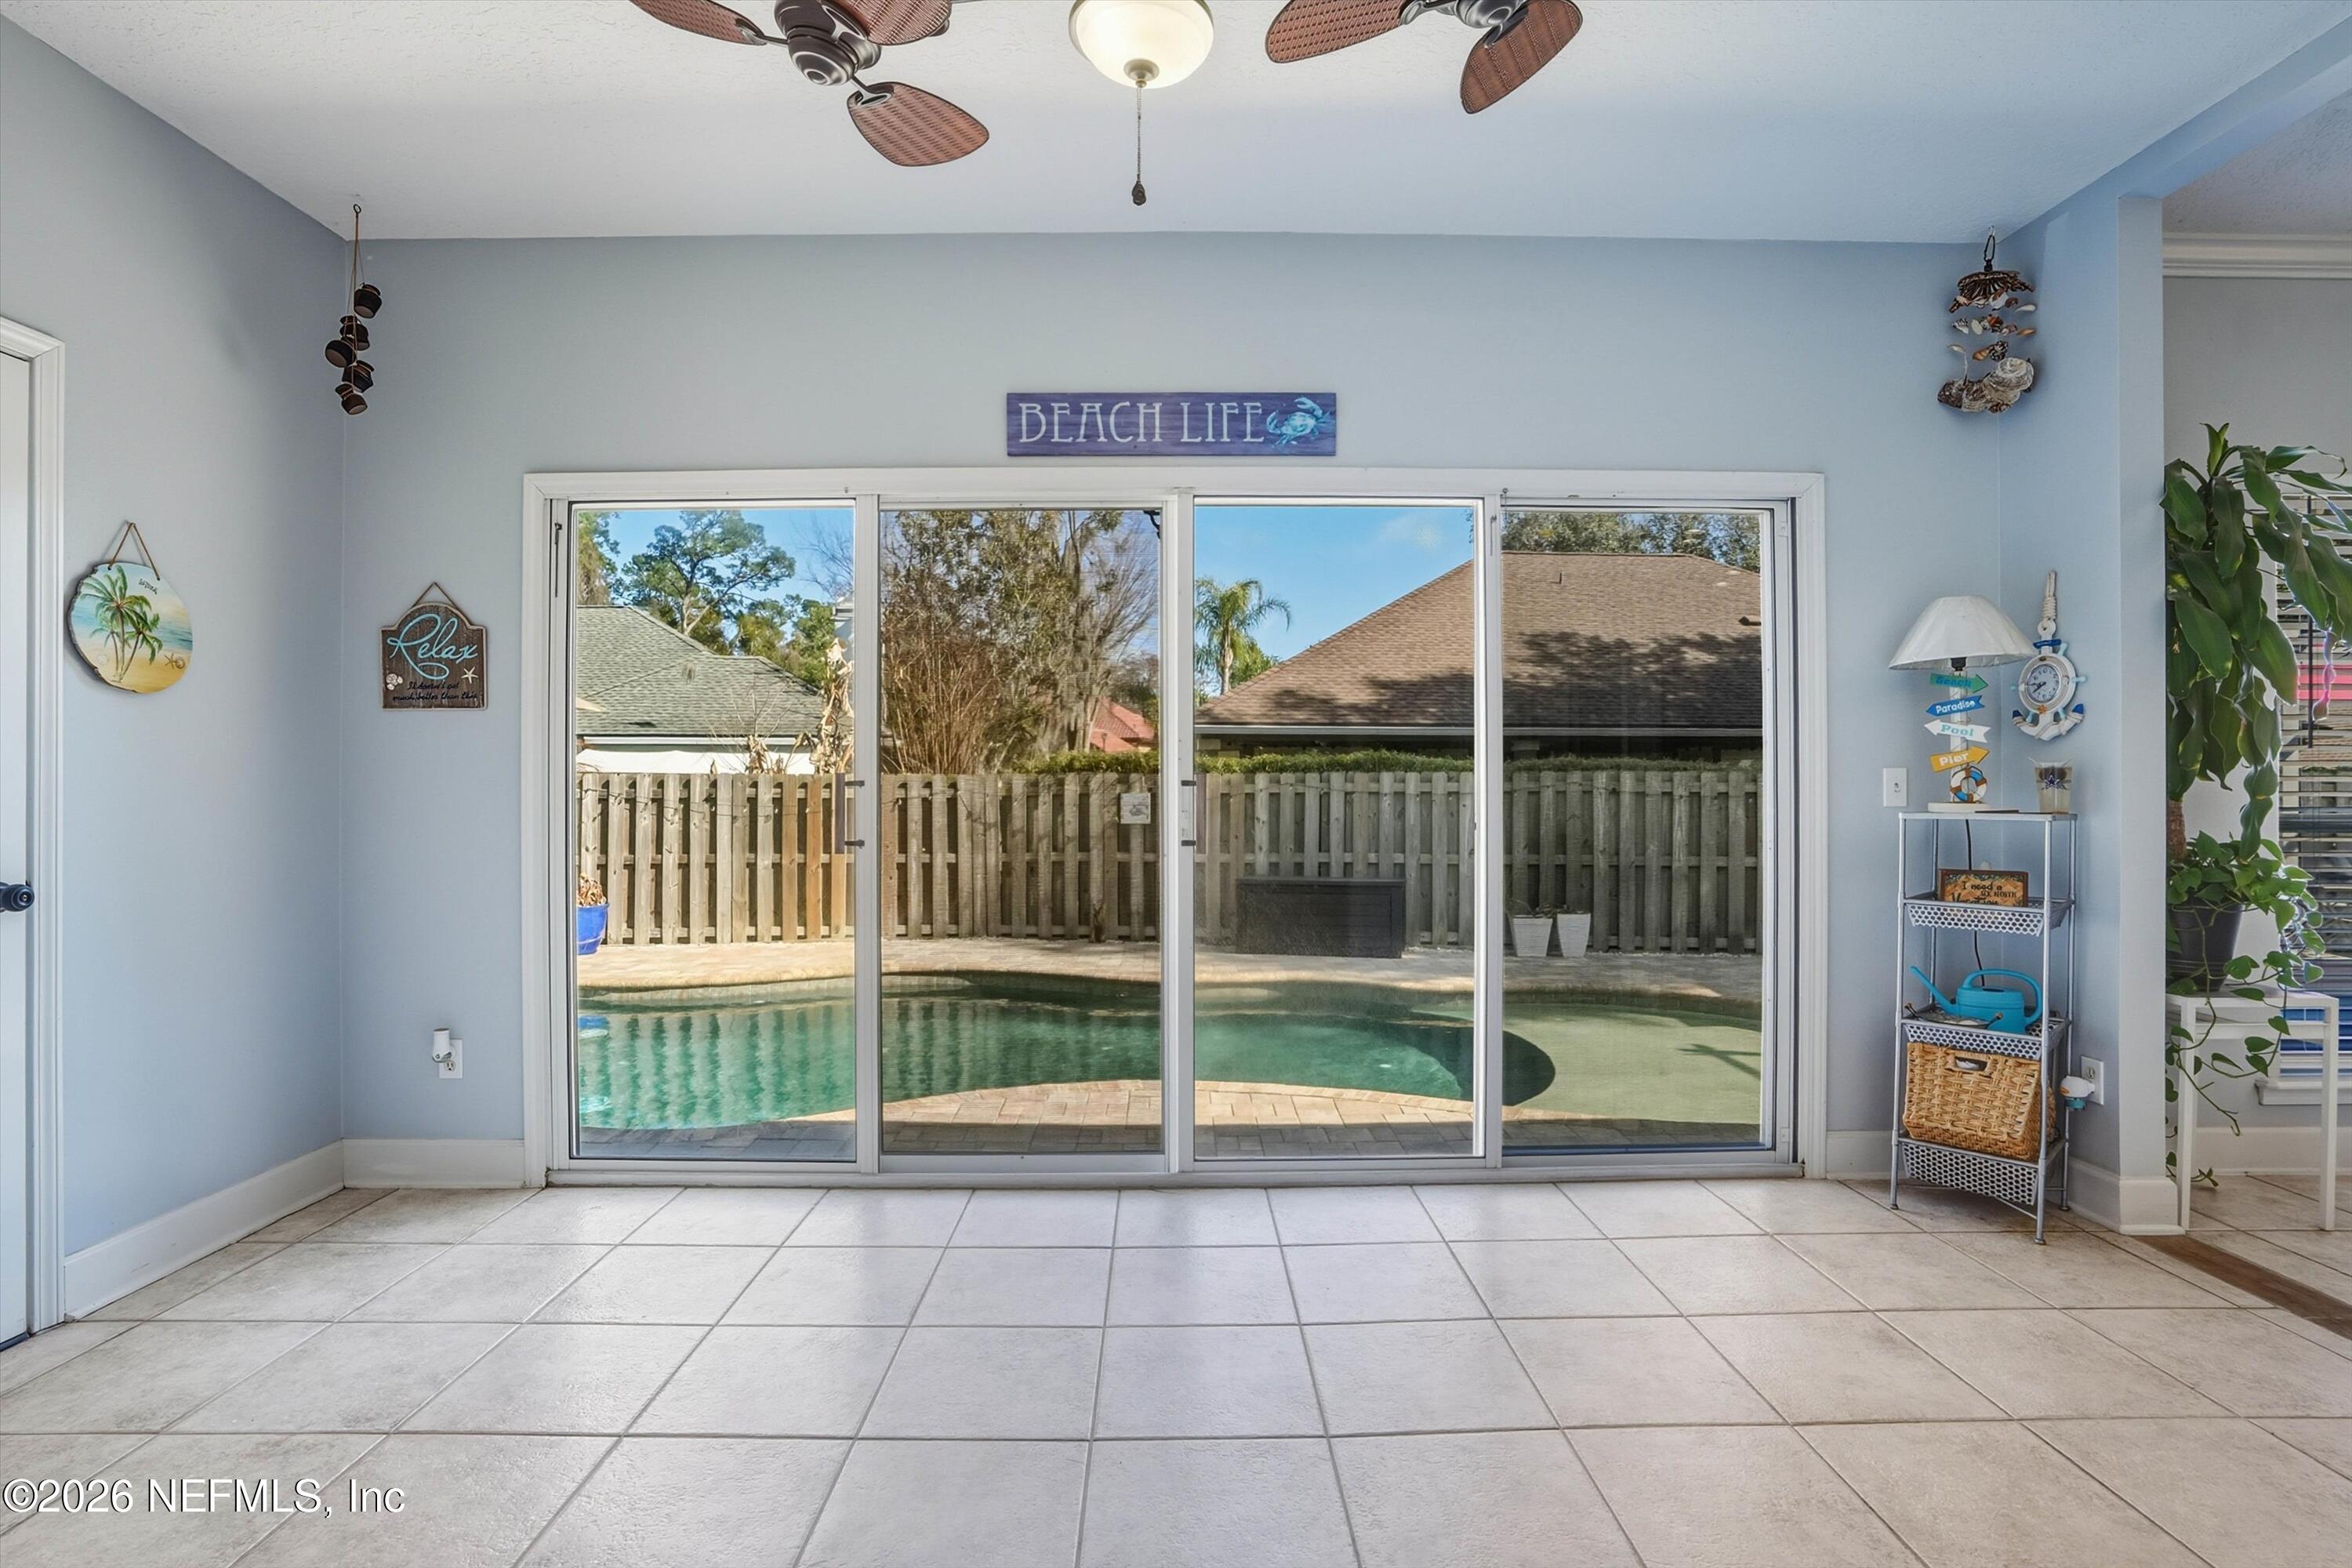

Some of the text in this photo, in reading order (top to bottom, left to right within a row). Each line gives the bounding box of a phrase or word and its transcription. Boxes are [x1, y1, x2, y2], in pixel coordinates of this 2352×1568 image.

[1018, 401, 1265, 443] BEACH LIFE
[387, 613, 478, 681] Relax
[1935, 699, 1976, 714] Paradise
[1940, 724, 1974, 737] Pool
[1938, 753, 1969, 767] Pier
[1962, 880, 1967, 891] I
[1970, 881, 1994, 891] need
